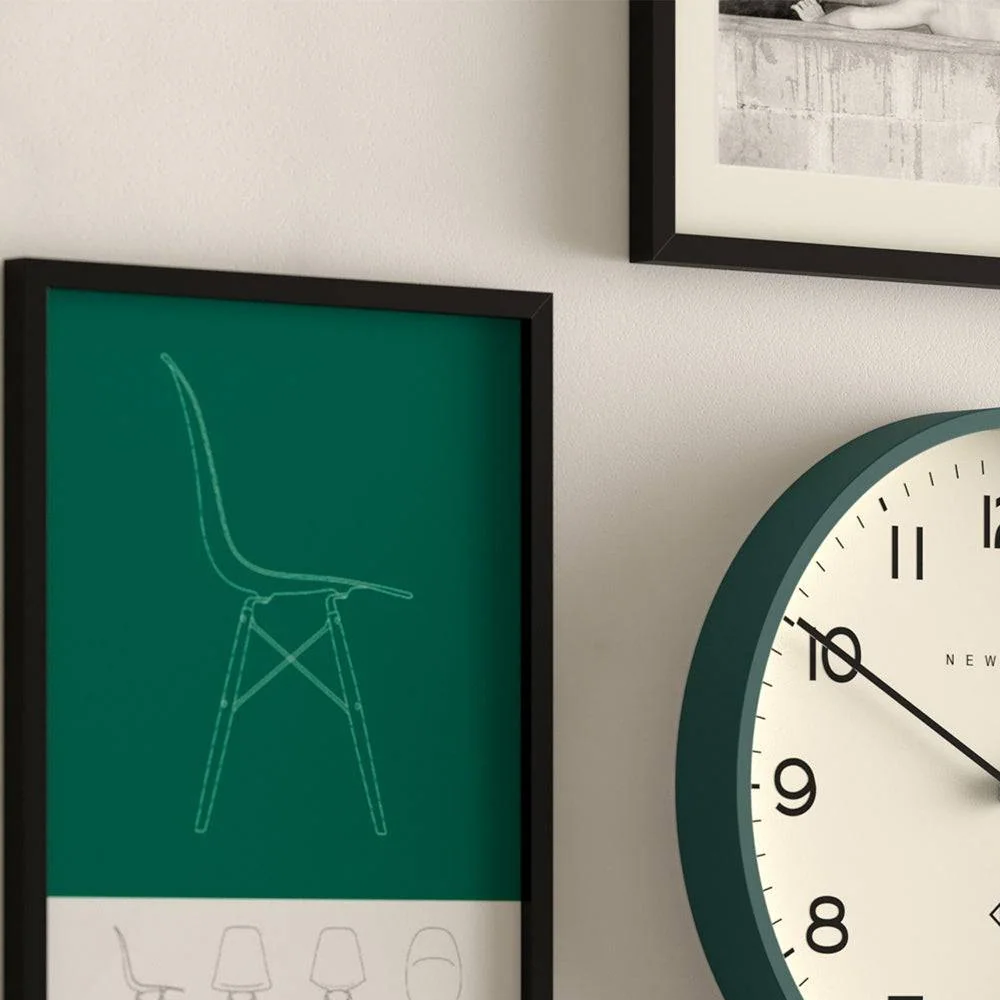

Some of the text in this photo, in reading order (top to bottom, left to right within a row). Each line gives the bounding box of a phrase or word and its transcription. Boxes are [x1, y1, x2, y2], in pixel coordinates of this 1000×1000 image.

[891, 525, 924, 580] 11
[809, 626, 862, 684] 10
[773, 757, 817, 817] 9
[805, 895, 849, 955] 8
